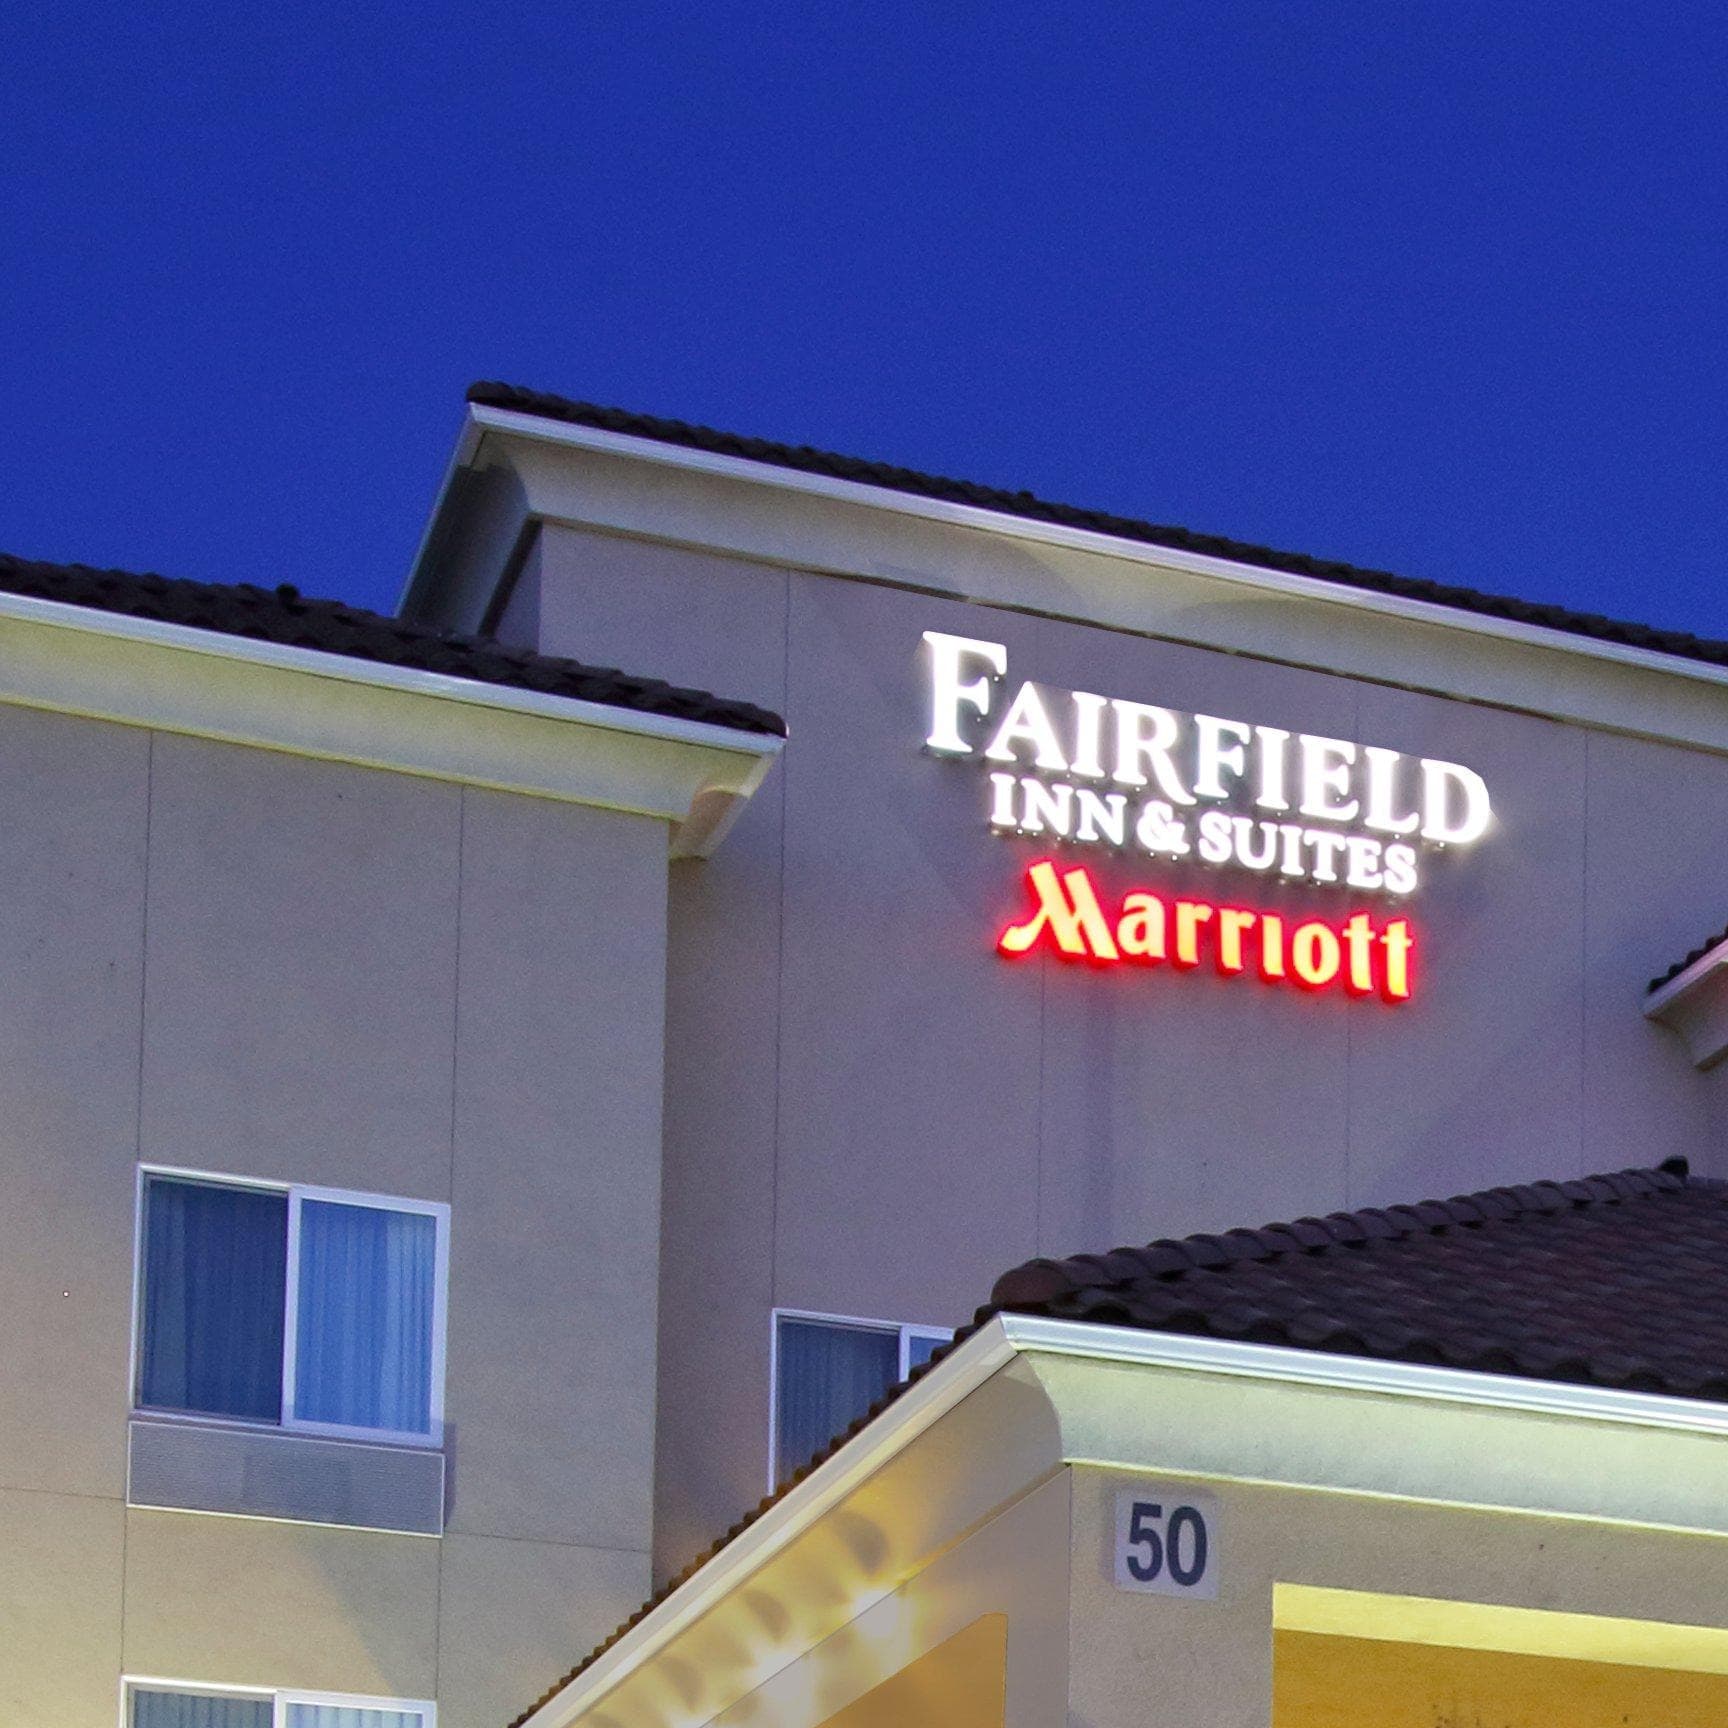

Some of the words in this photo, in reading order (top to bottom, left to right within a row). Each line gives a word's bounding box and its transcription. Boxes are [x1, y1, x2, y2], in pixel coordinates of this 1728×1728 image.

[920, 629, 1495, 845] FAIRFIELD
[989, 772, 1129, 846] INN
[1135, 799, 1192, 856] &
[1197, 810, 1419, 895] SUITES
[995, 858, 1418, 1003] Marriott
[1126, 1502, 1207, 1587] 50
